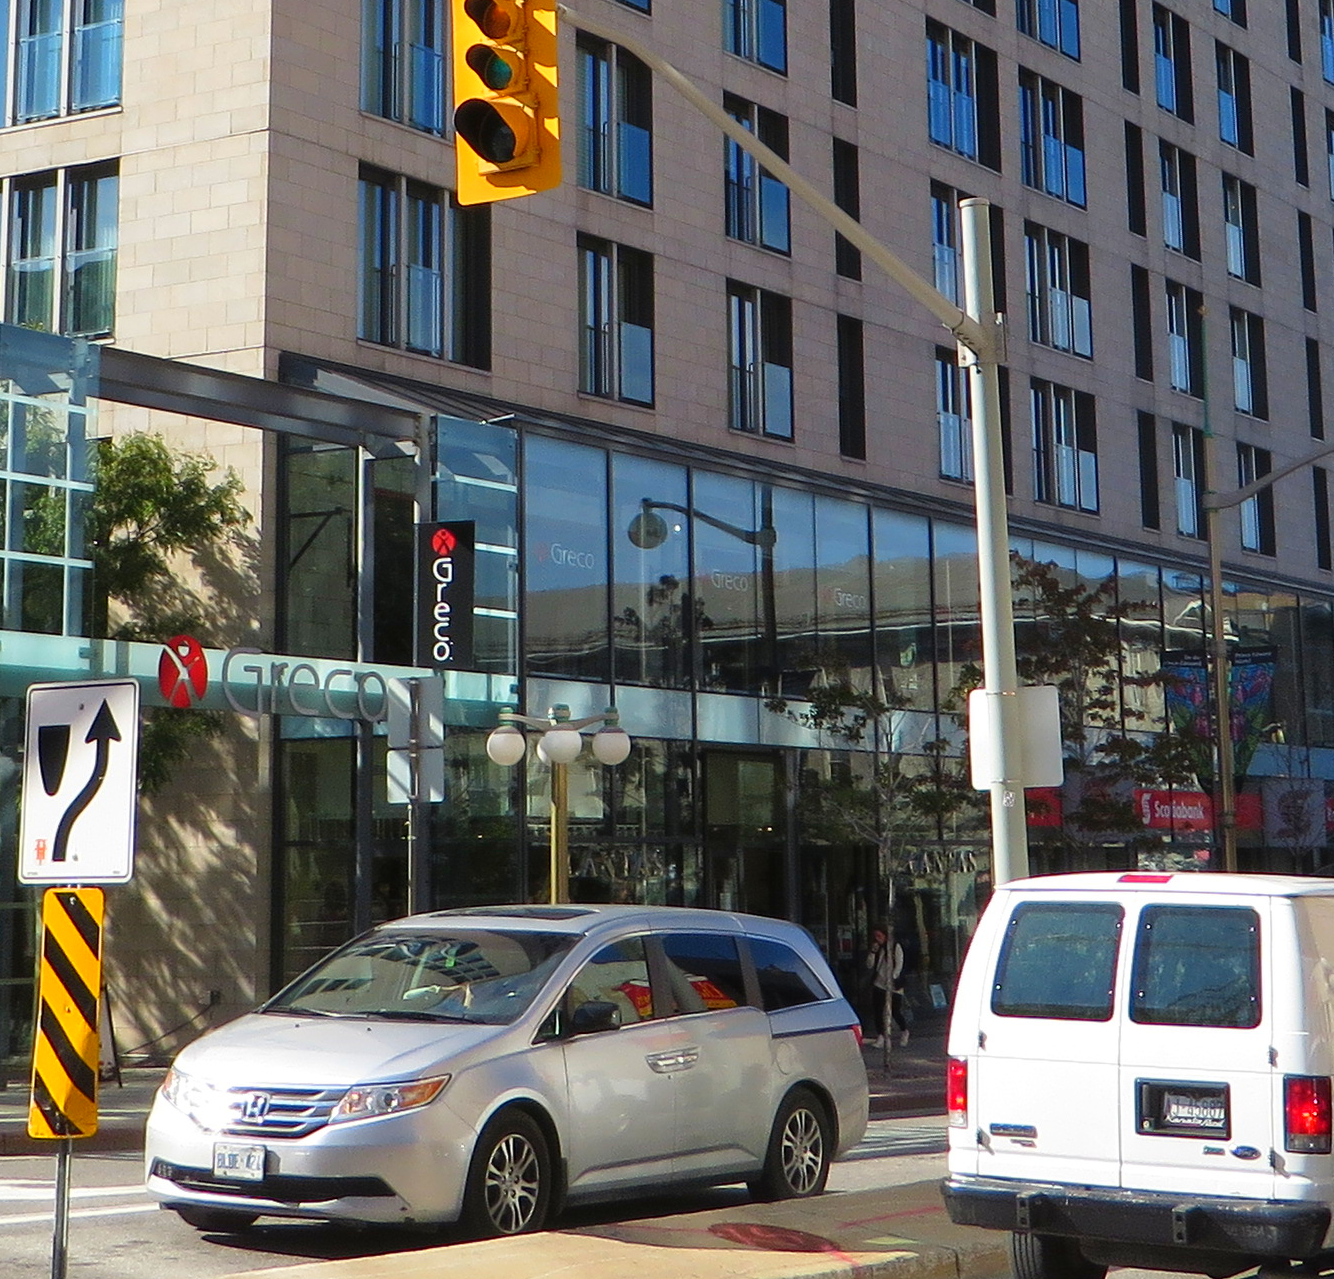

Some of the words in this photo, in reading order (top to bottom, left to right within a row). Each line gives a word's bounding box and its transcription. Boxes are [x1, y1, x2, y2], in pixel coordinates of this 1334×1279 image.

[550, 542, 595, 570] Greco
[711, 569, 749, 592] Greco
[432, 557, 453, 661] Greco
[834, 588, 867, 609] Greco
[222, 646, 388, 722] Greco
[1154, 800, 1204, 820] Scotiabank
